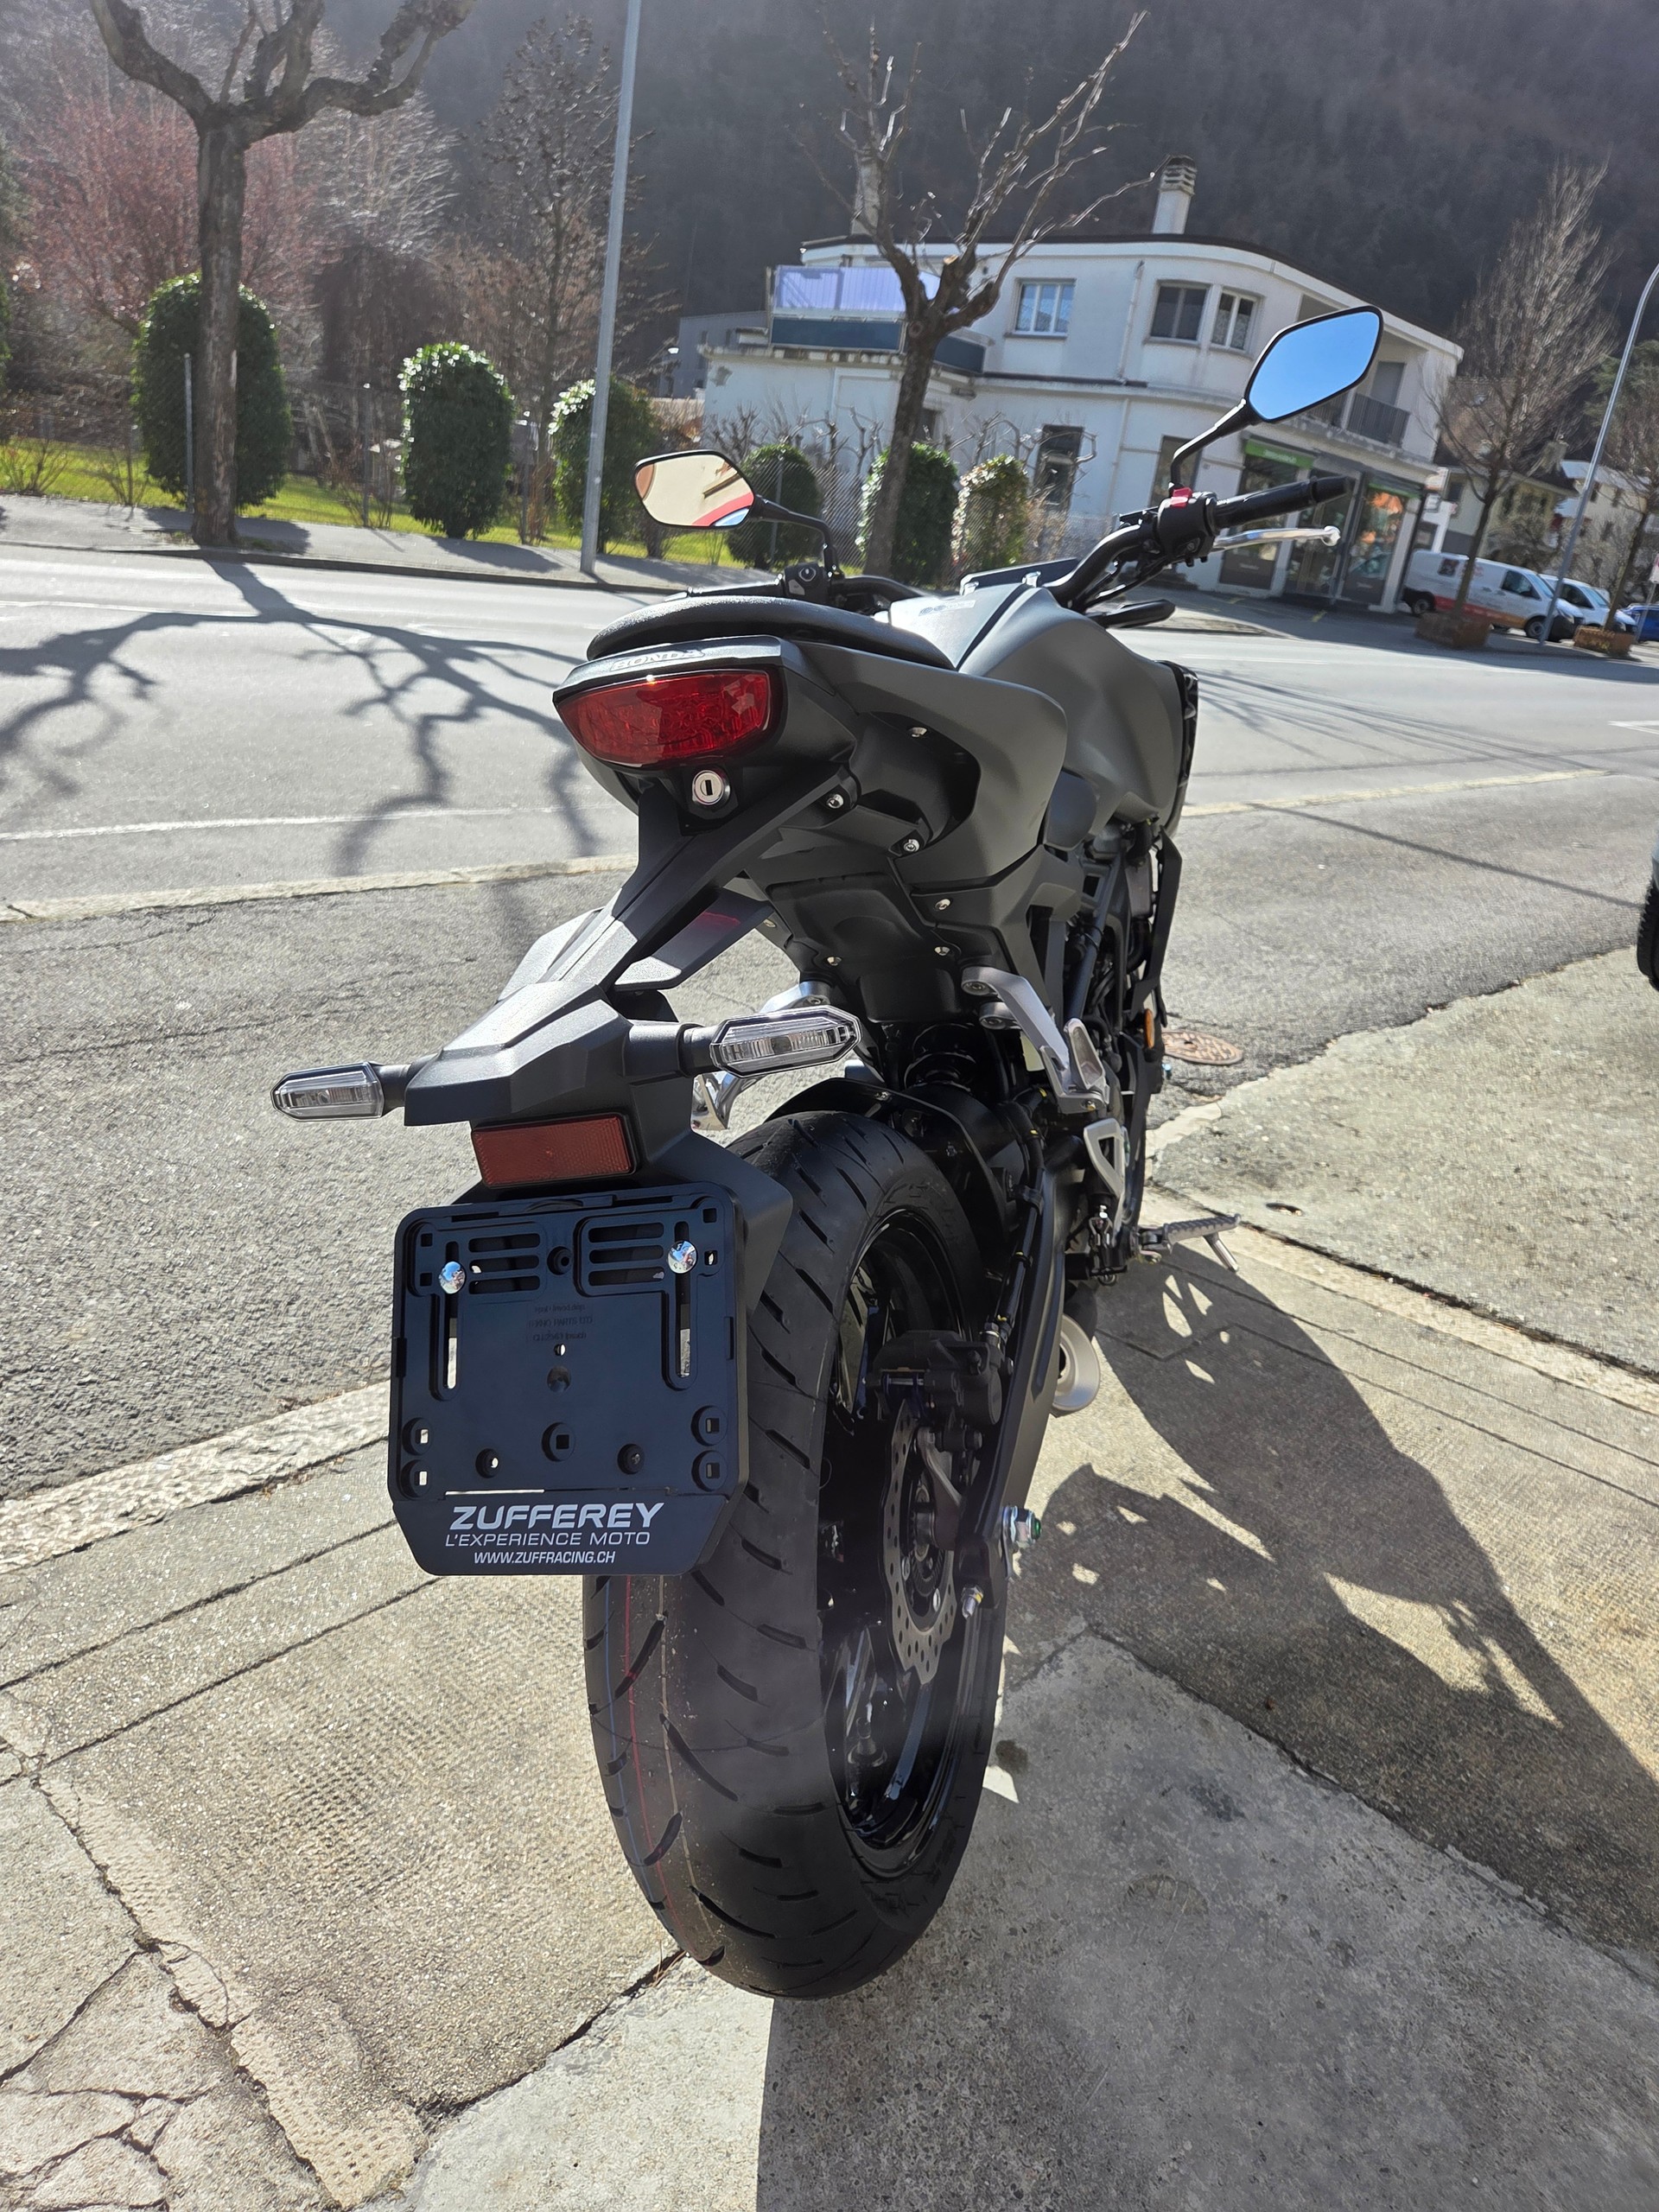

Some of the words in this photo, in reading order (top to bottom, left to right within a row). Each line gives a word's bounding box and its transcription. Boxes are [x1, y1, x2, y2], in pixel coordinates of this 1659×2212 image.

[449, 1502, 664, 1530] ZUFFEREY
[445, 1532, 582, 1548] L'EXPERIENCE
[589, 1531, 651, 1546] MOTO
[474, 1550, 616, 1565] WWW.ZUFFRACING.CH
